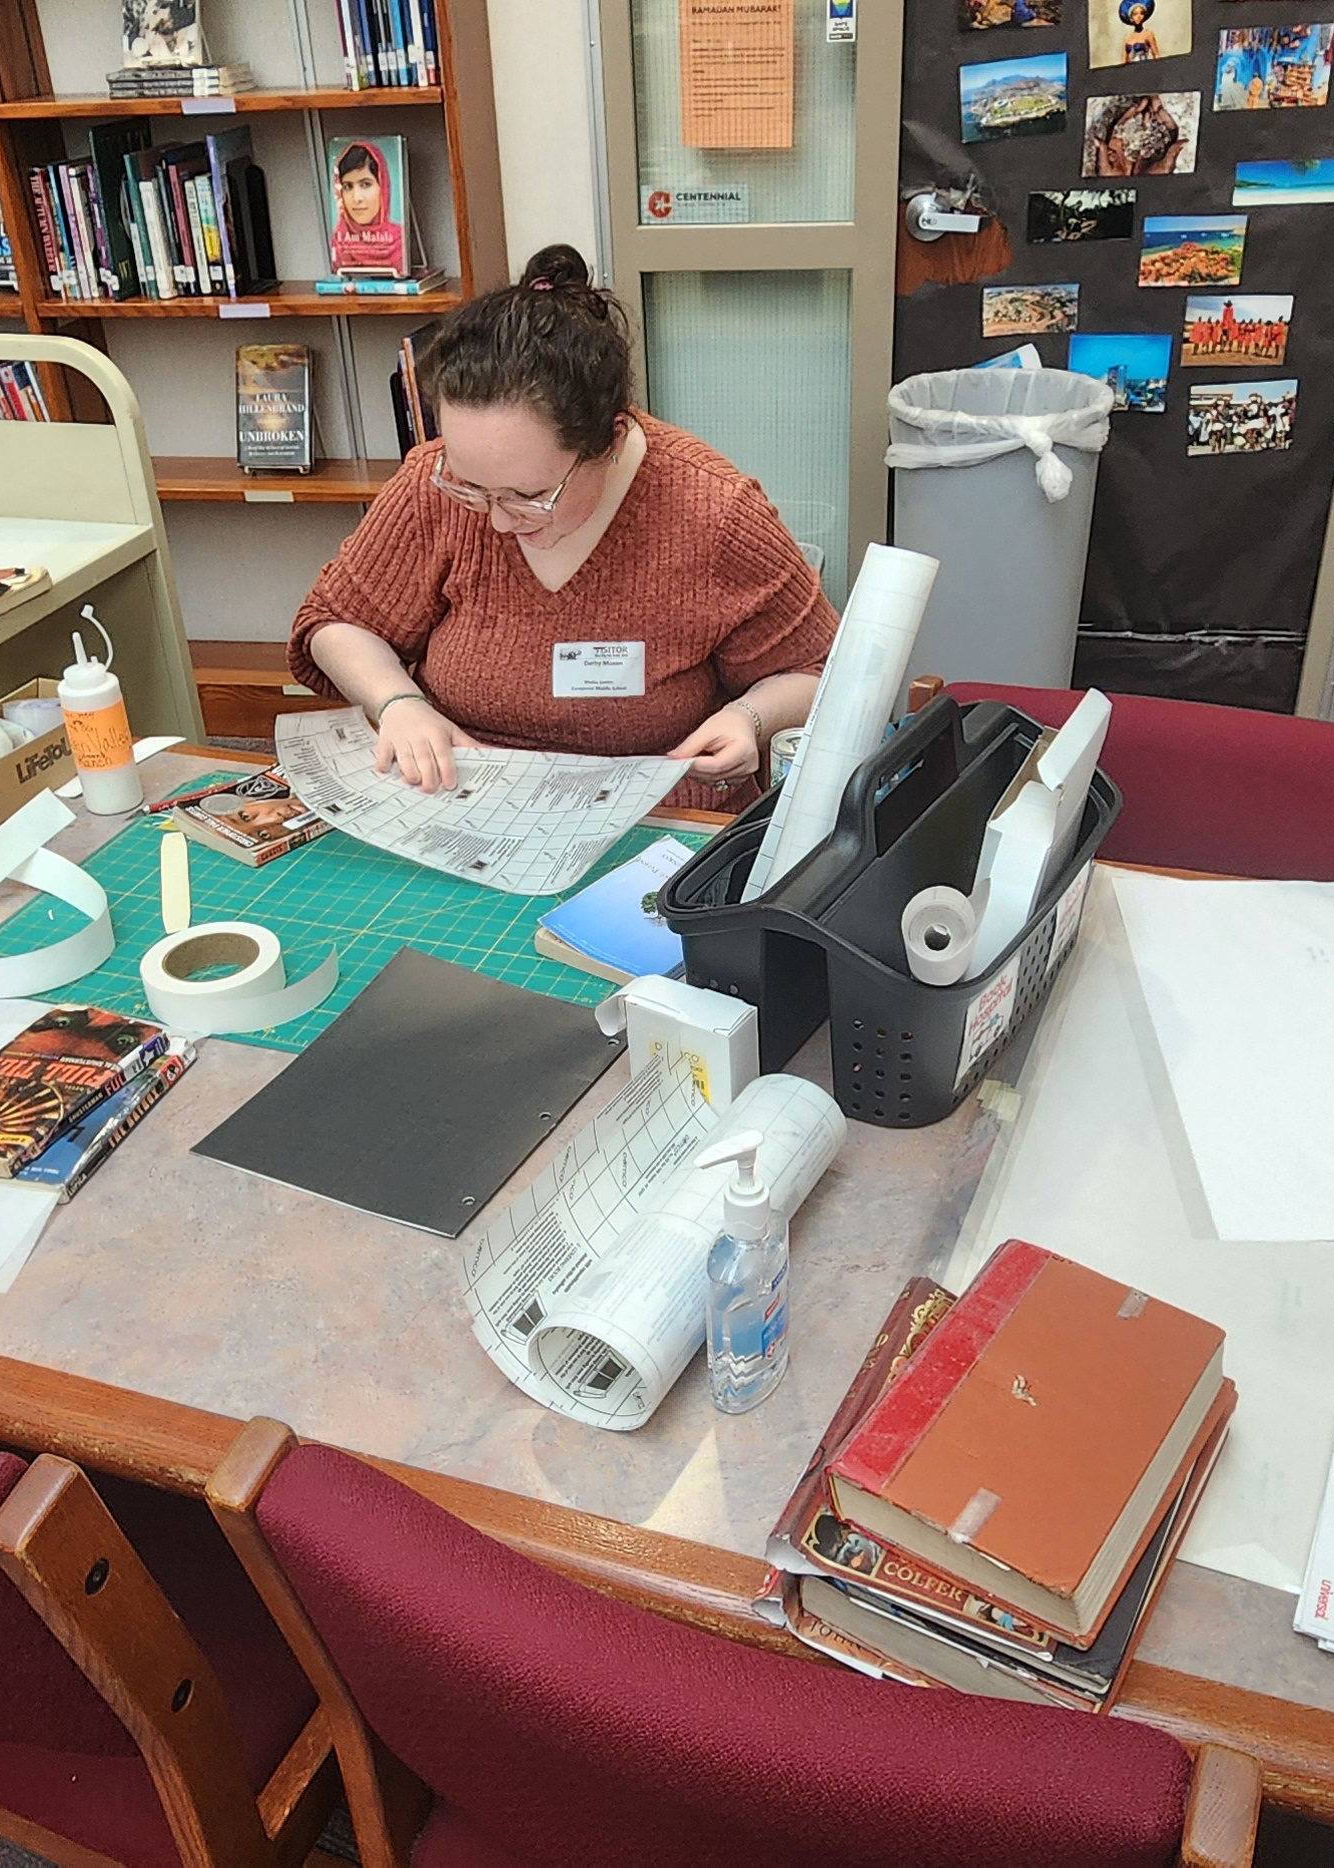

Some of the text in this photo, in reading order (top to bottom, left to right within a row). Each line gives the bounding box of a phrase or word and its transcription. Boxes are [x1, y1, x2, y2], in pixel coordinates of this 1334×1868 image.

[692, 6, 734, 14] RAMADAN
[675, 192, 741, 201] CENTENNIAL
[344, 233, 359, 242] Am
[362, 231, 393, 242] Malala
[256, 393, 287, 402] LAURA
[239, 404, 305, 413] HILLENBRAND
[239, 430, 305, 442] UNBROKEN
[979, 975, 1007, 1011] Book
[969, 978, 1013, 1035] Hospital
[41, 1063, 118, 1089] FULL
[883, 1561, 964, 1602] COLFER
